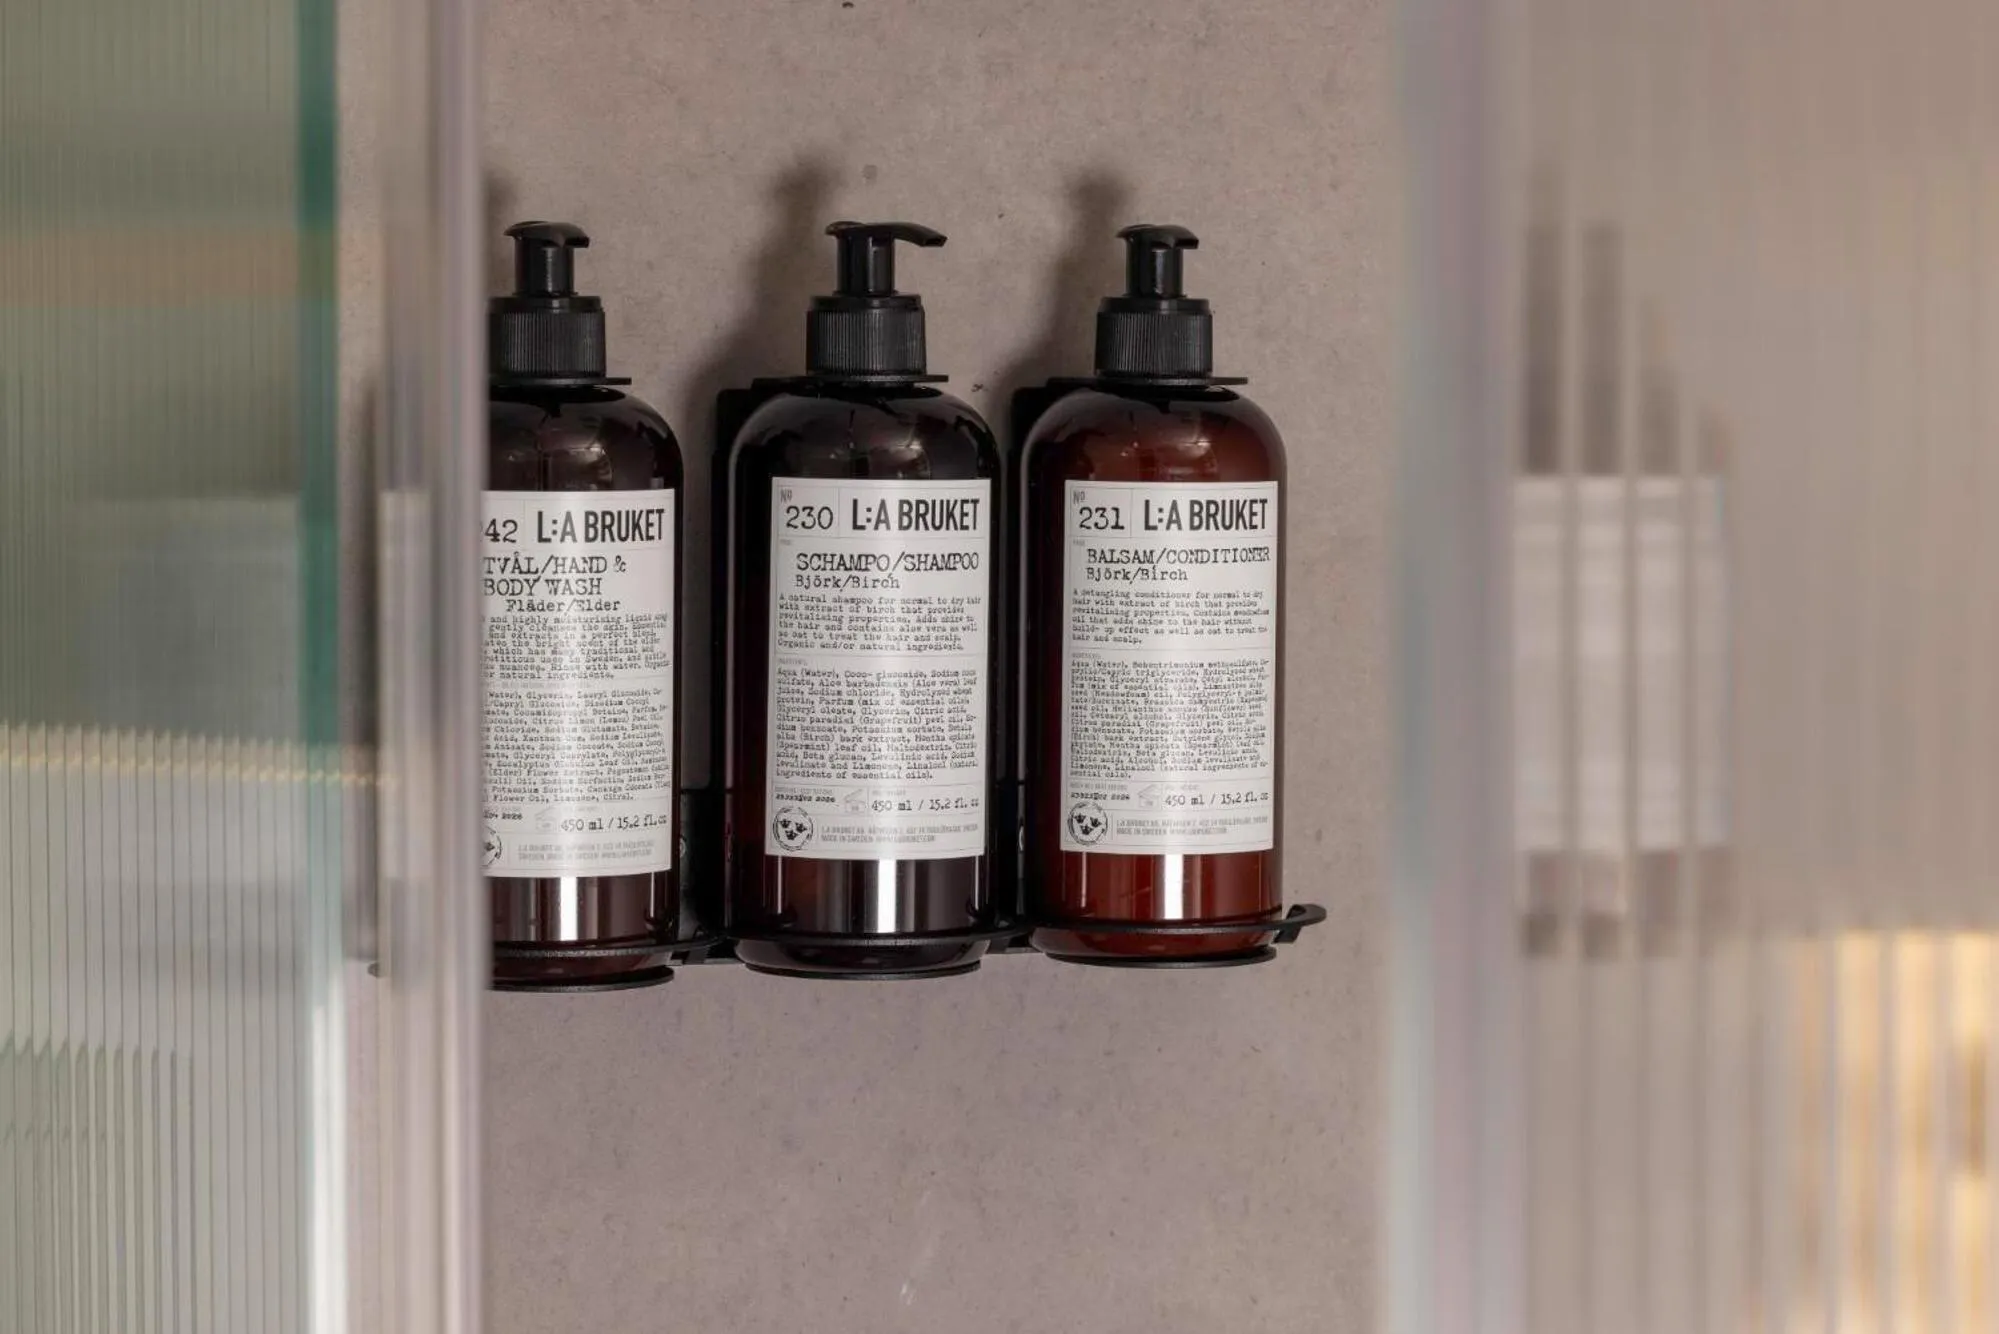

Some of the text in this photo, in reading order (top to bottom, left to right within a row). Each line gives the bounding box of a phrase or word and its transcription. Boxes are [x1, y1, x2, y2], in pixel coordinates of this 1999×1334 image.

[786, 506, 834, 530] 230
[852, 498, 980, 531] L:A BRUKET
[1079, 506, 1125, 530] 231
[1144, 498, 1268, 531] L:A BRUKET
[480, 518, 518, 544] 42
[537, 508, 665, 543] L:A BRUKET
[484, 551, 627, 575] TVÅL/HAND &
[796, 552, 980, 572] SCHAMPO/SHAMPOO
[1086, 547, 1270, 566] BALSAM/CONDITIONER
[796, 573, 900, 592] Björk/Birch
[1086, 566, 1188, 584] Björk/Birch
[484, 576, 603, 596] BODY WASH
[1135, 590, 1191, 599] conditioner
[1196, 591, 1208, 599] for
[779, 601, 799, 610] with
[849, 605, 862, 613] of
[867, 606, 896, 614] birch
[901, 606, 922, 614] that
[788, 594, 826, 603] natural
[832, 594, 874, 606] shampoo
[878, 596, 896, 604] for
[900, 596, 934, 604] normal
[938, 596, 948, 604] to
[951, 596, 964, 606] dry
[512, 615, 548, 626] highly
[779, 620, 794, 628] the
[798, 622, 820, 630] hair
[812, 632, 824, 640] to
[820, 641, 855, 650] and/or
[836, 770, 846, 779] of
[872, 800, 892, 812] 450
[898, 800, 912, 811] ml
[929, 798, 950, 811] 15.2
[1164, 794, 1186, 806] 450
[1190, 794, 1204, 806] ml
[1220, 792, 1242, 805] 15.2
[588, 817, 604, 830] ml
[617, 815, 640, 830] 15.2
